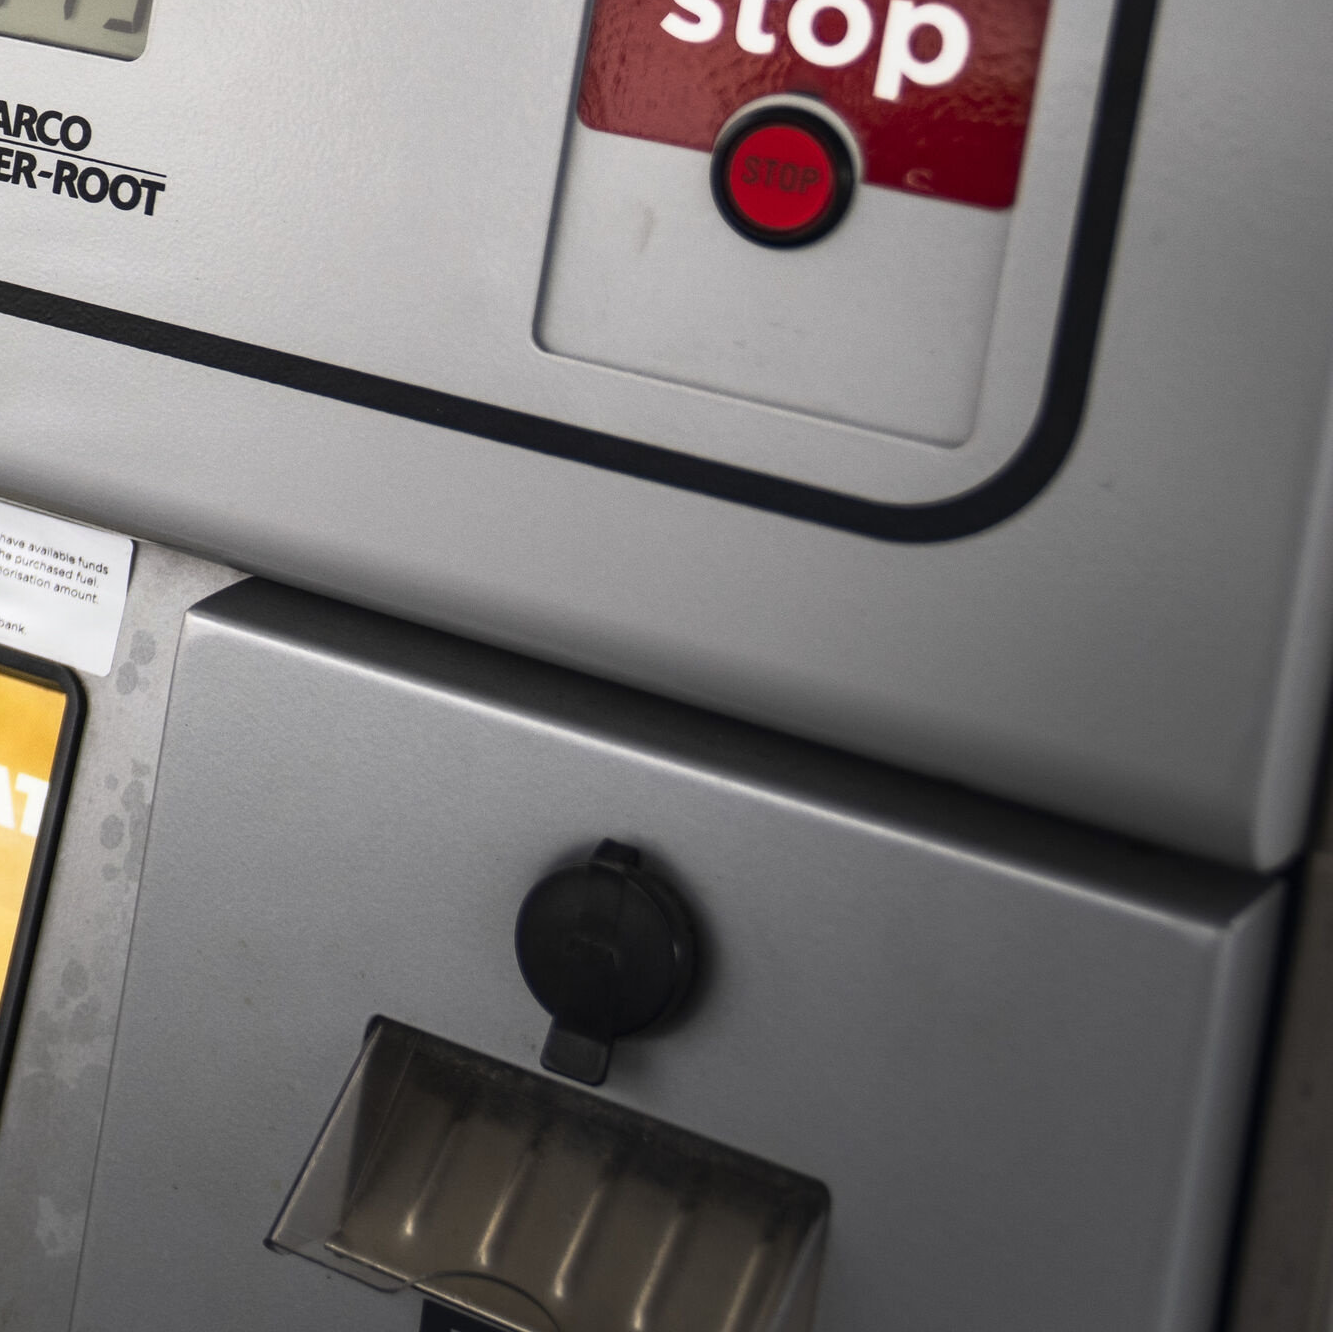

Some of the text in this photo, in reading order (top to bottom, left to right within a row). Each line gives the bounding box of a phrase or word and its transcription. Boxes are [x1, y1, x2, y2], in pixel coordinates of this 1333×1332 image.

[742, 155, 820, 194] STOP
[14, 552, 73, 581] purchased
[75, 571, 100, 587] fuel.
[27, 541, 76, 564] available
[77, 556, 109, 574] funds
